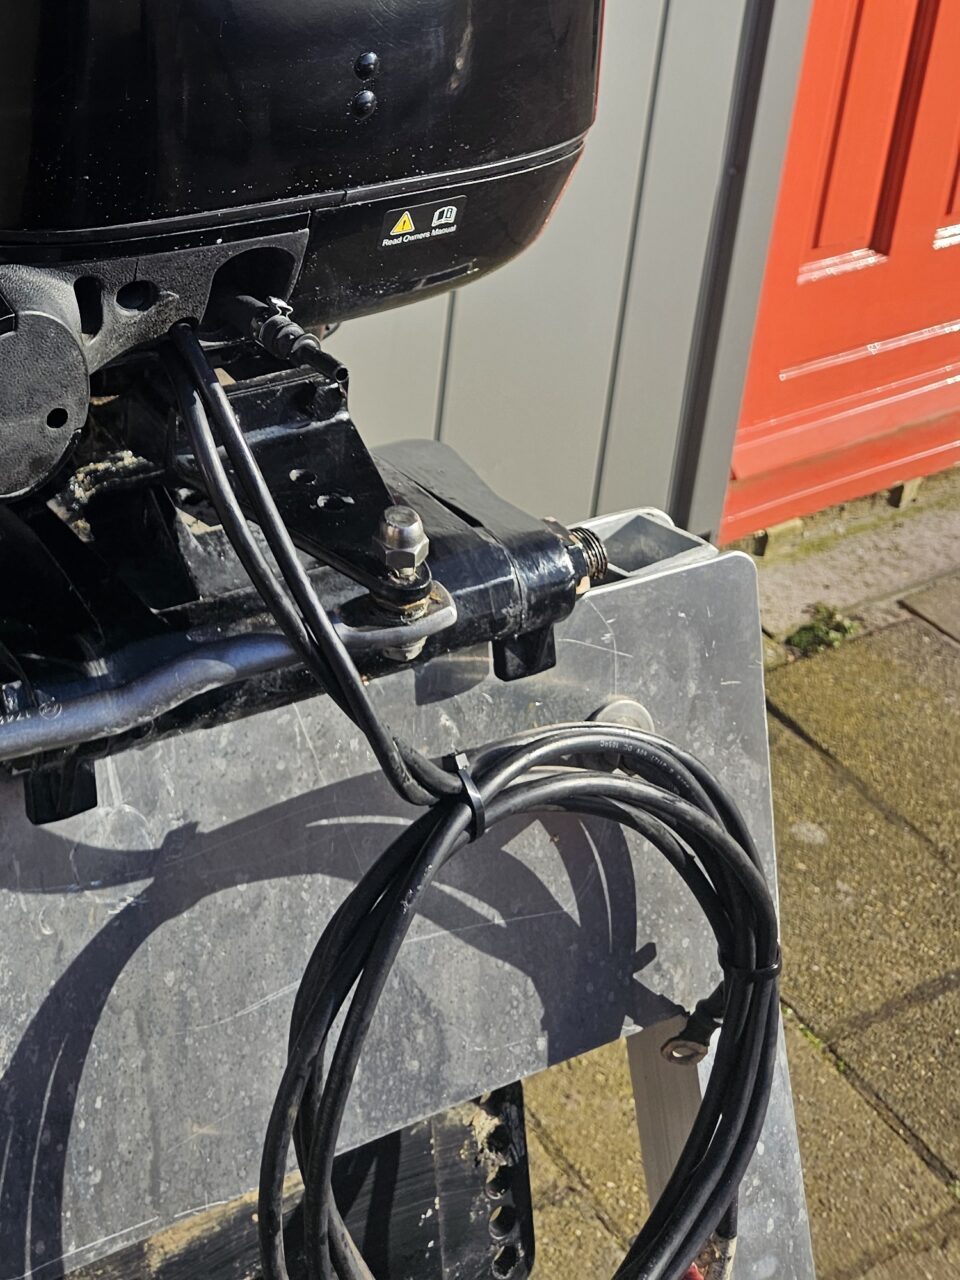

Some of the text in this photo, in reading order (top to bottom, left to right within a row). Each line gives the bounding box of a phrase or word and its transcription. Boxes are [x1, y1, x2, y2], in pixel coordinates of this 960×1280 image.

[381, 224, 457, 247] Read Owners Manual
